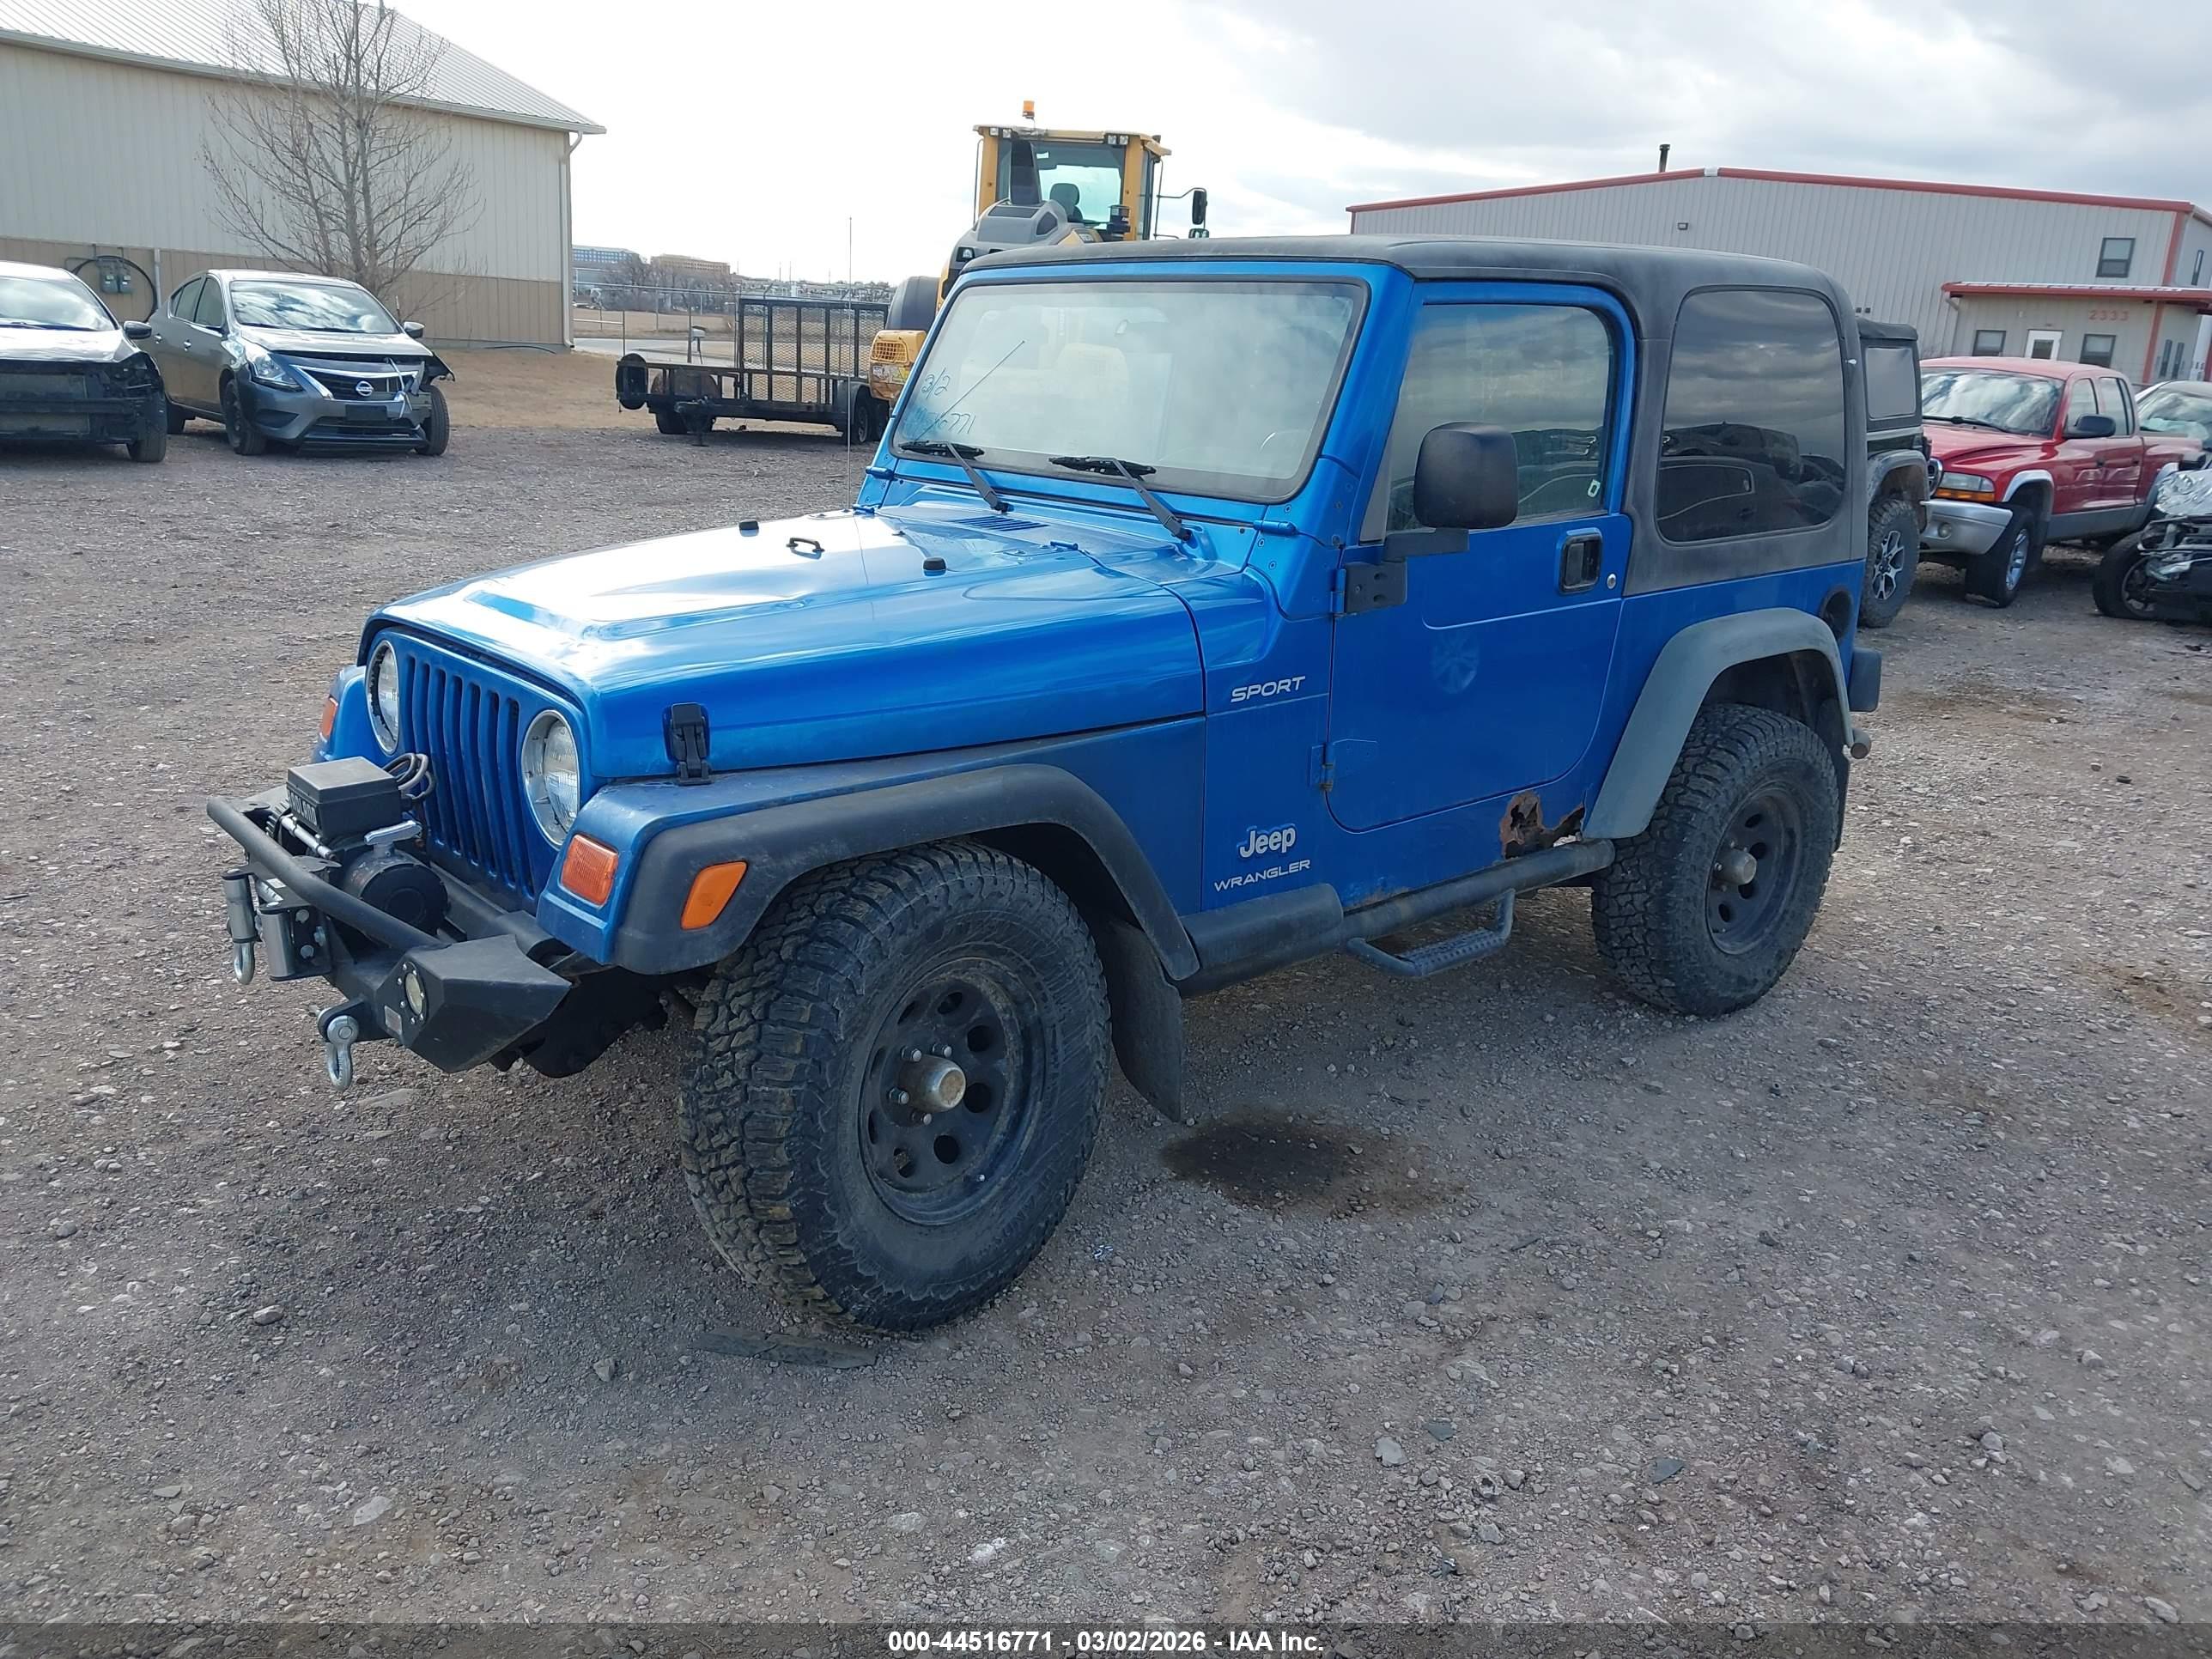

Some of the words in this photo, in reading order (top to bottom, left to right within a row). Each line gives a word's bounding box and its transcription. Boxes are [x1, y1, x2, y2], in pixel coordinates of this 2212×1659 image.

[2087, 309, 2130, 322] 2333
[921, 367, 951, 399] 3/2
[1231, 676, 1306, 702] SPORT
[1237, 824, 1297, 858] Jeep
[1214, 860, 1310, 892] WRANGLER
